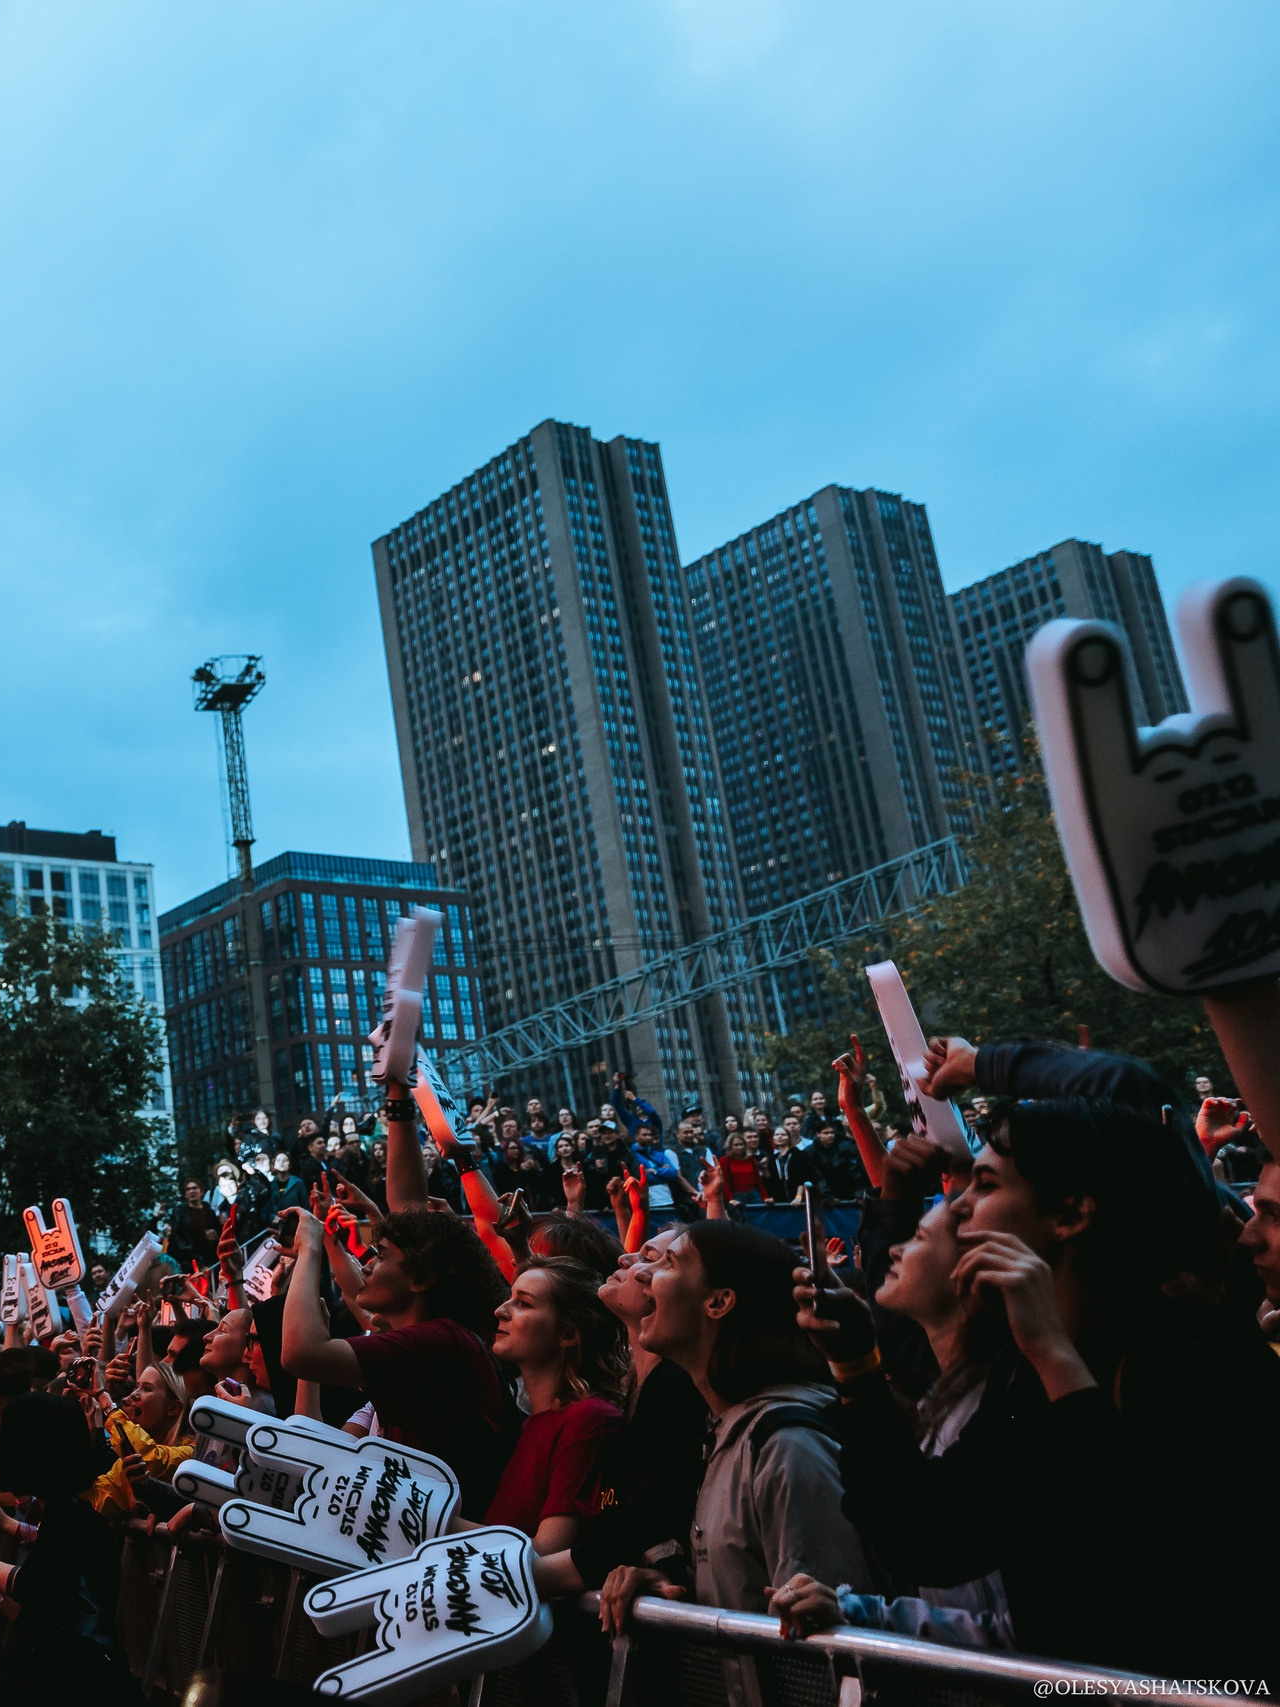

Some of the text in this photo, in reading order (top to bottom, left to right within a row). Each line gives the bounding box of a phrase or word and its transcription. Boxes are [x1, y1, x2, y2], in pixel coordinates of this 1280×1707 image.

[260, 1467, 277, 1492] 07.
[270, 1471, 290, 1508] STAD
[327, 1475, 351, 1516] 07.12
[339, 1465, 373, 1537] STADIUM
[405, 1580, 419, 1622] 07.12
[420, 1563, 440, 1632] STADIUM
